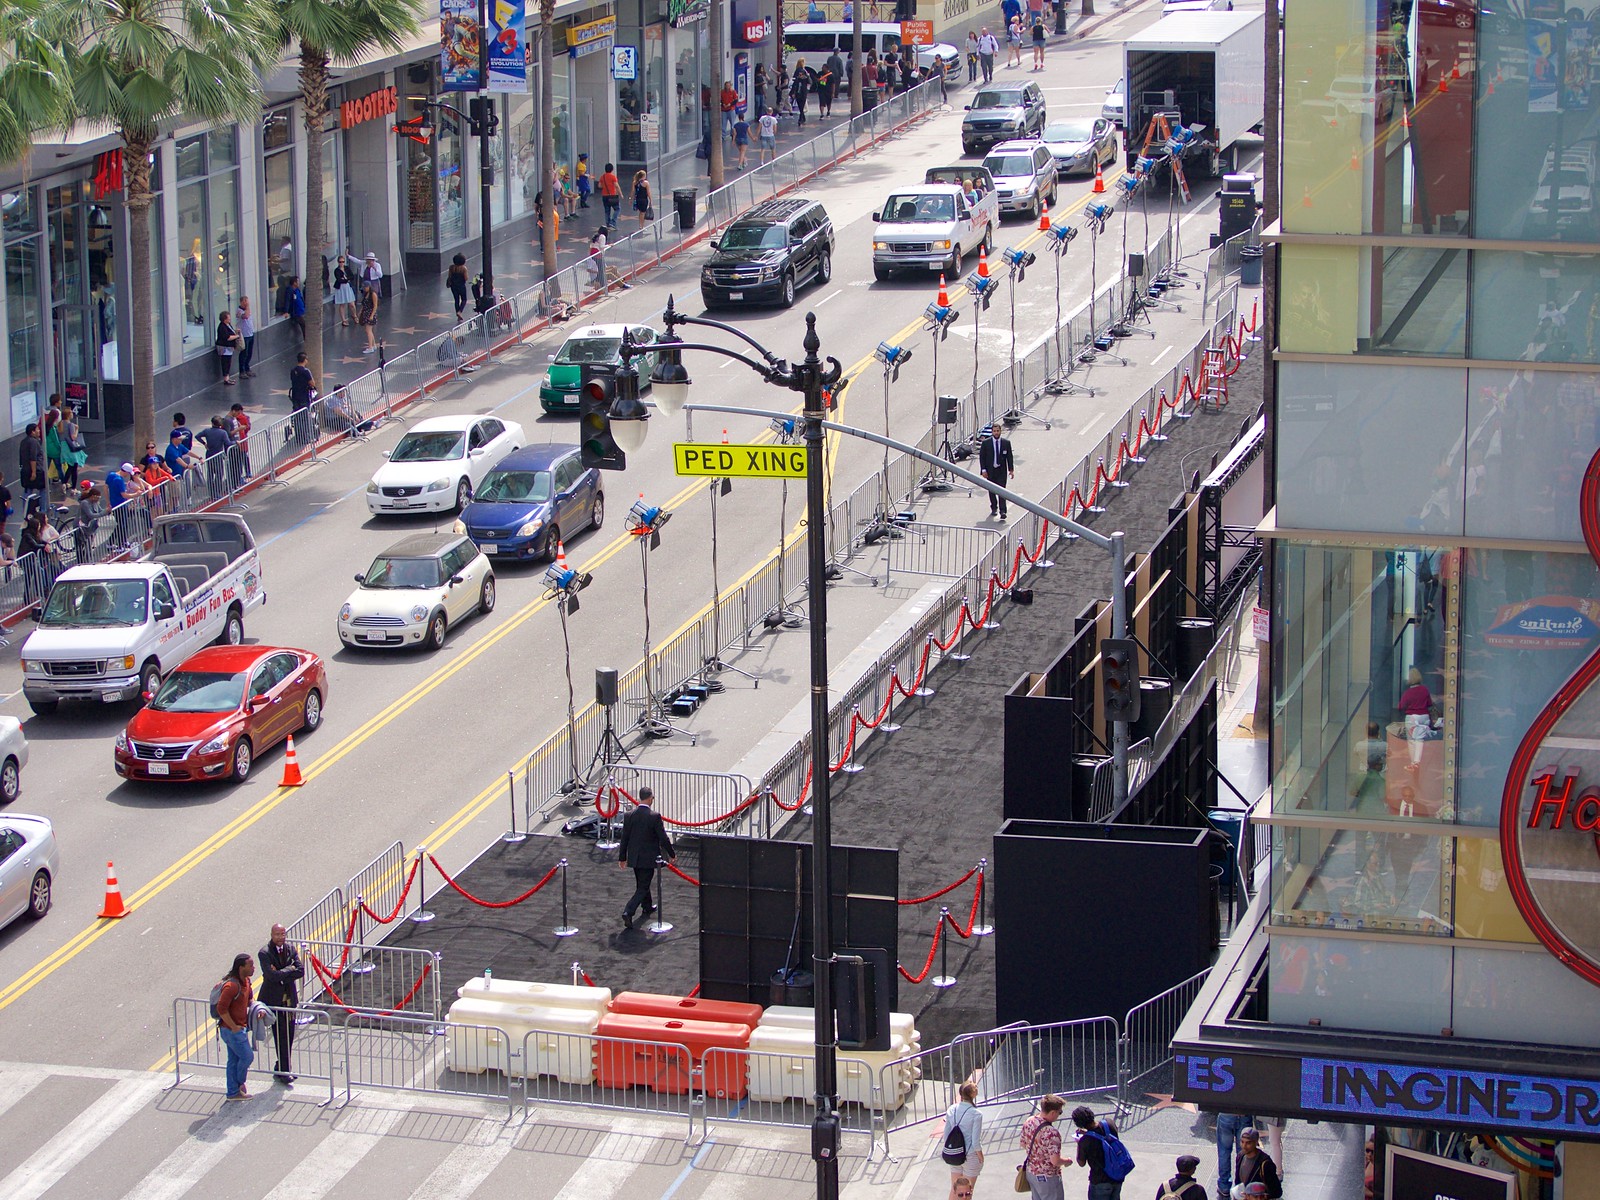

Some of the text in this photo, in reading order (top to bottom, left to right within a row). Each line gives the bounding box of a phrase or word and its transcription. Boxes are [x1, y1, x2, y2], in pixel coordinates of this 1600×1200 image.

[345, 86, 398, 129] HOOTERS
[685, 450, 805, 472] PED XING
[186, 606, 207, 629] Buddy
[209, 597, 221, 613] Fun
[1322, 1065, 1521, 1119] IMAGINE
